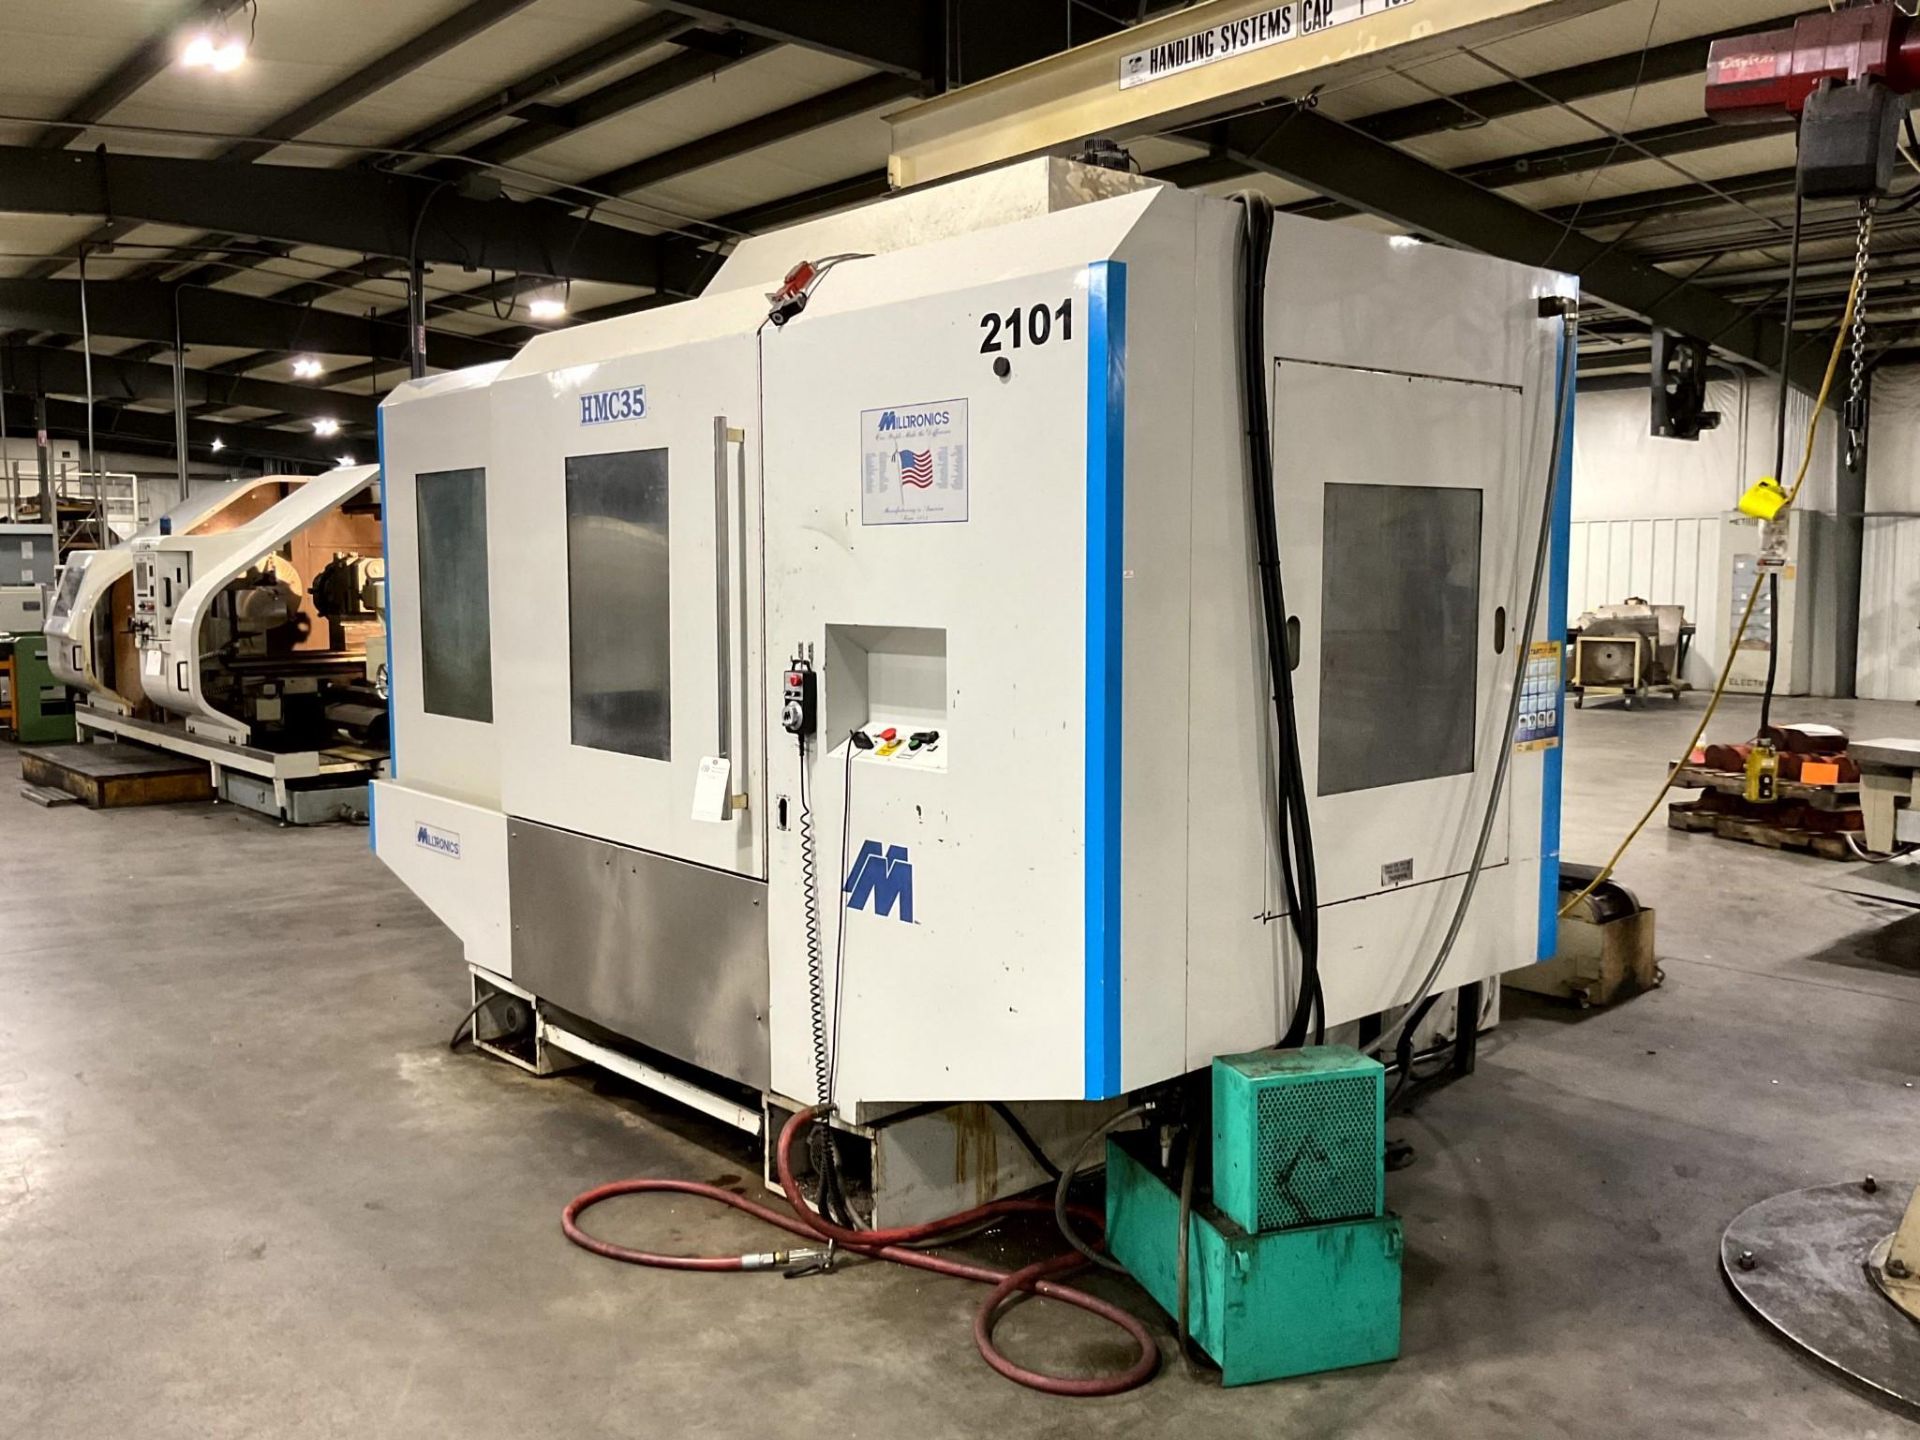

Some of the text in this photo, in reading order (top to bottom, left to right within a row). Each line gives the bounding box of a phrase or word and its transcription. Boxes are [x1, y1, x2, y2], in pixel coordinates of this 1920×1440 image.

[1150, 6, 1291, 75] HANDLING SYSTEMS
[980, 298, 1072, 354] 2101
[580, 387, 645, 424] HMC35
[877, 411, 951, 432] MILLTRONICS
